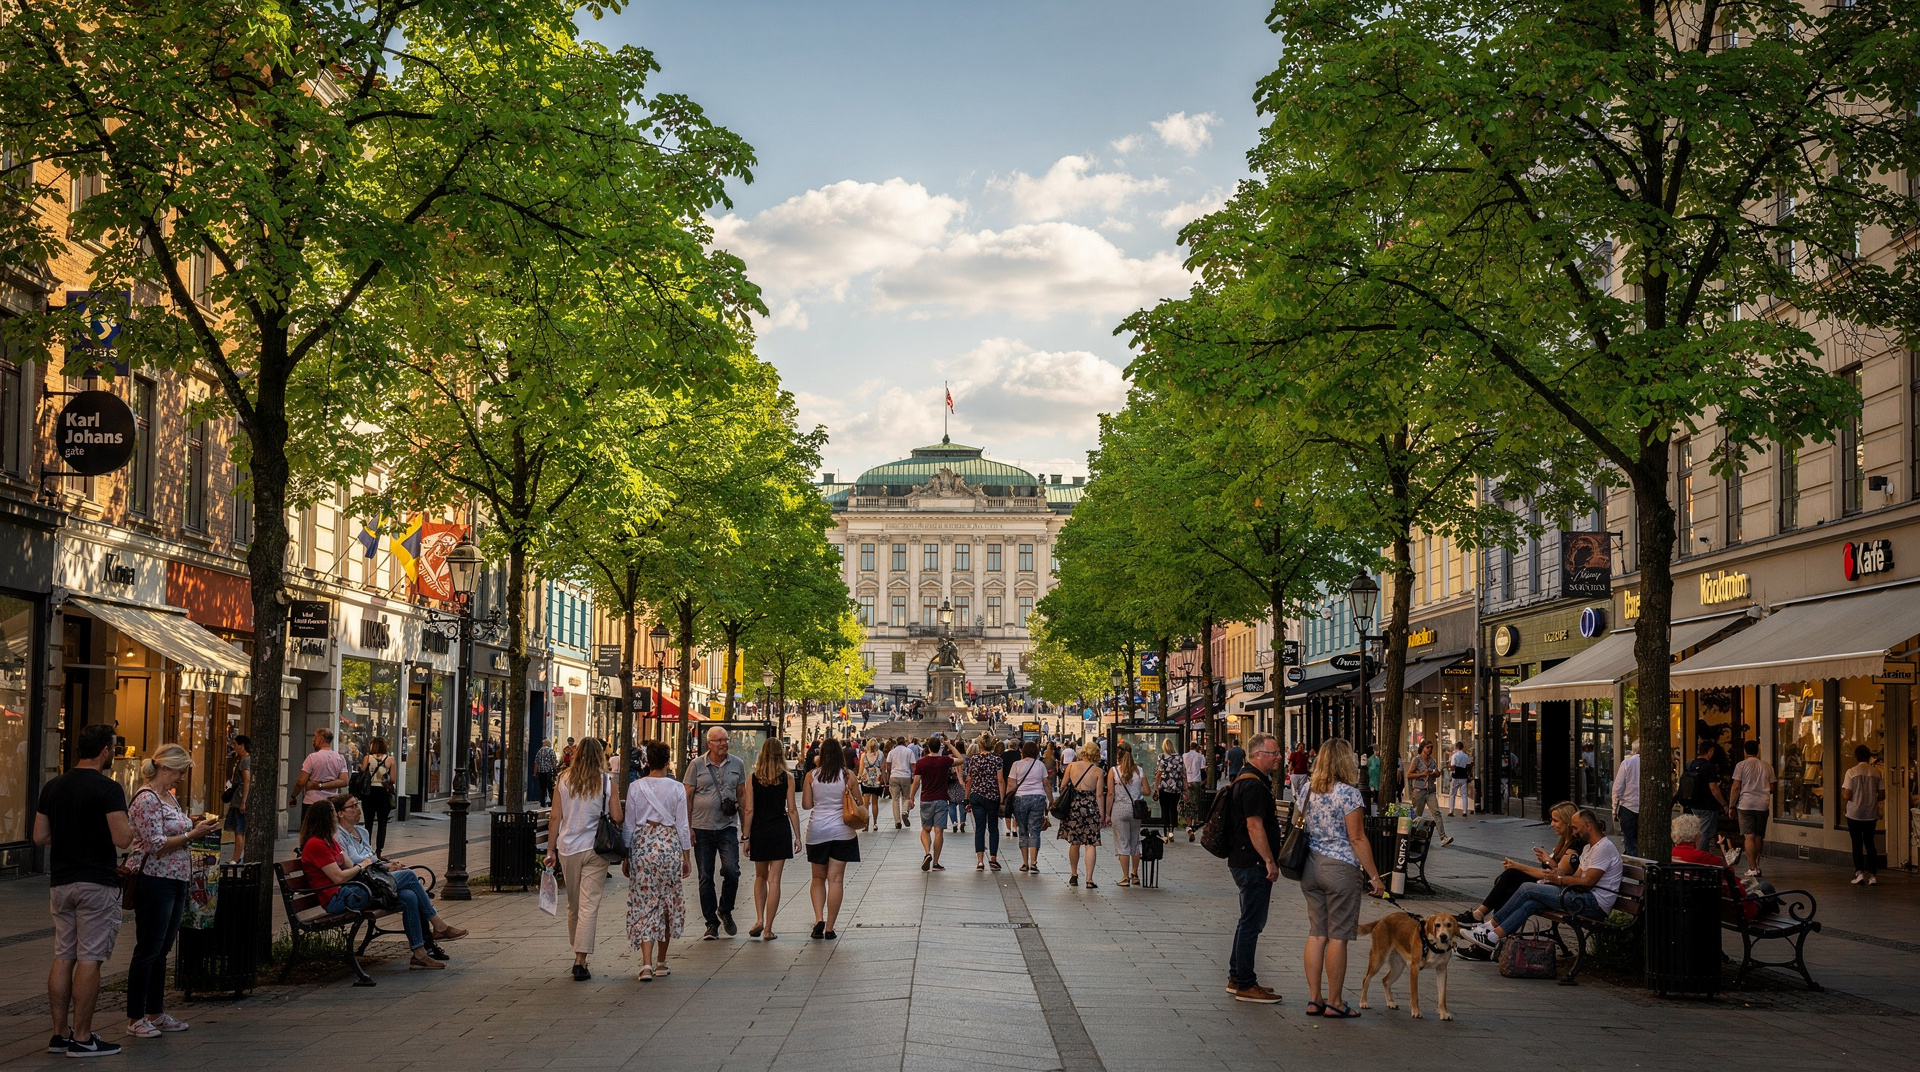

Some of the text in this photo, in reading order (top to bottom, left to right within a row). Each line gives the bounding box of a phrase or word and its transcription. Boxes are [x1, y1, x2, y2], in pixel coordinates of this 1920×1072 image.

[65, 412, 100, 427] Karl
[65, 429, 123, 444] Johans
[65, 446, 85, 458] gate
[1857, 540, 1885, 574] Kafé
